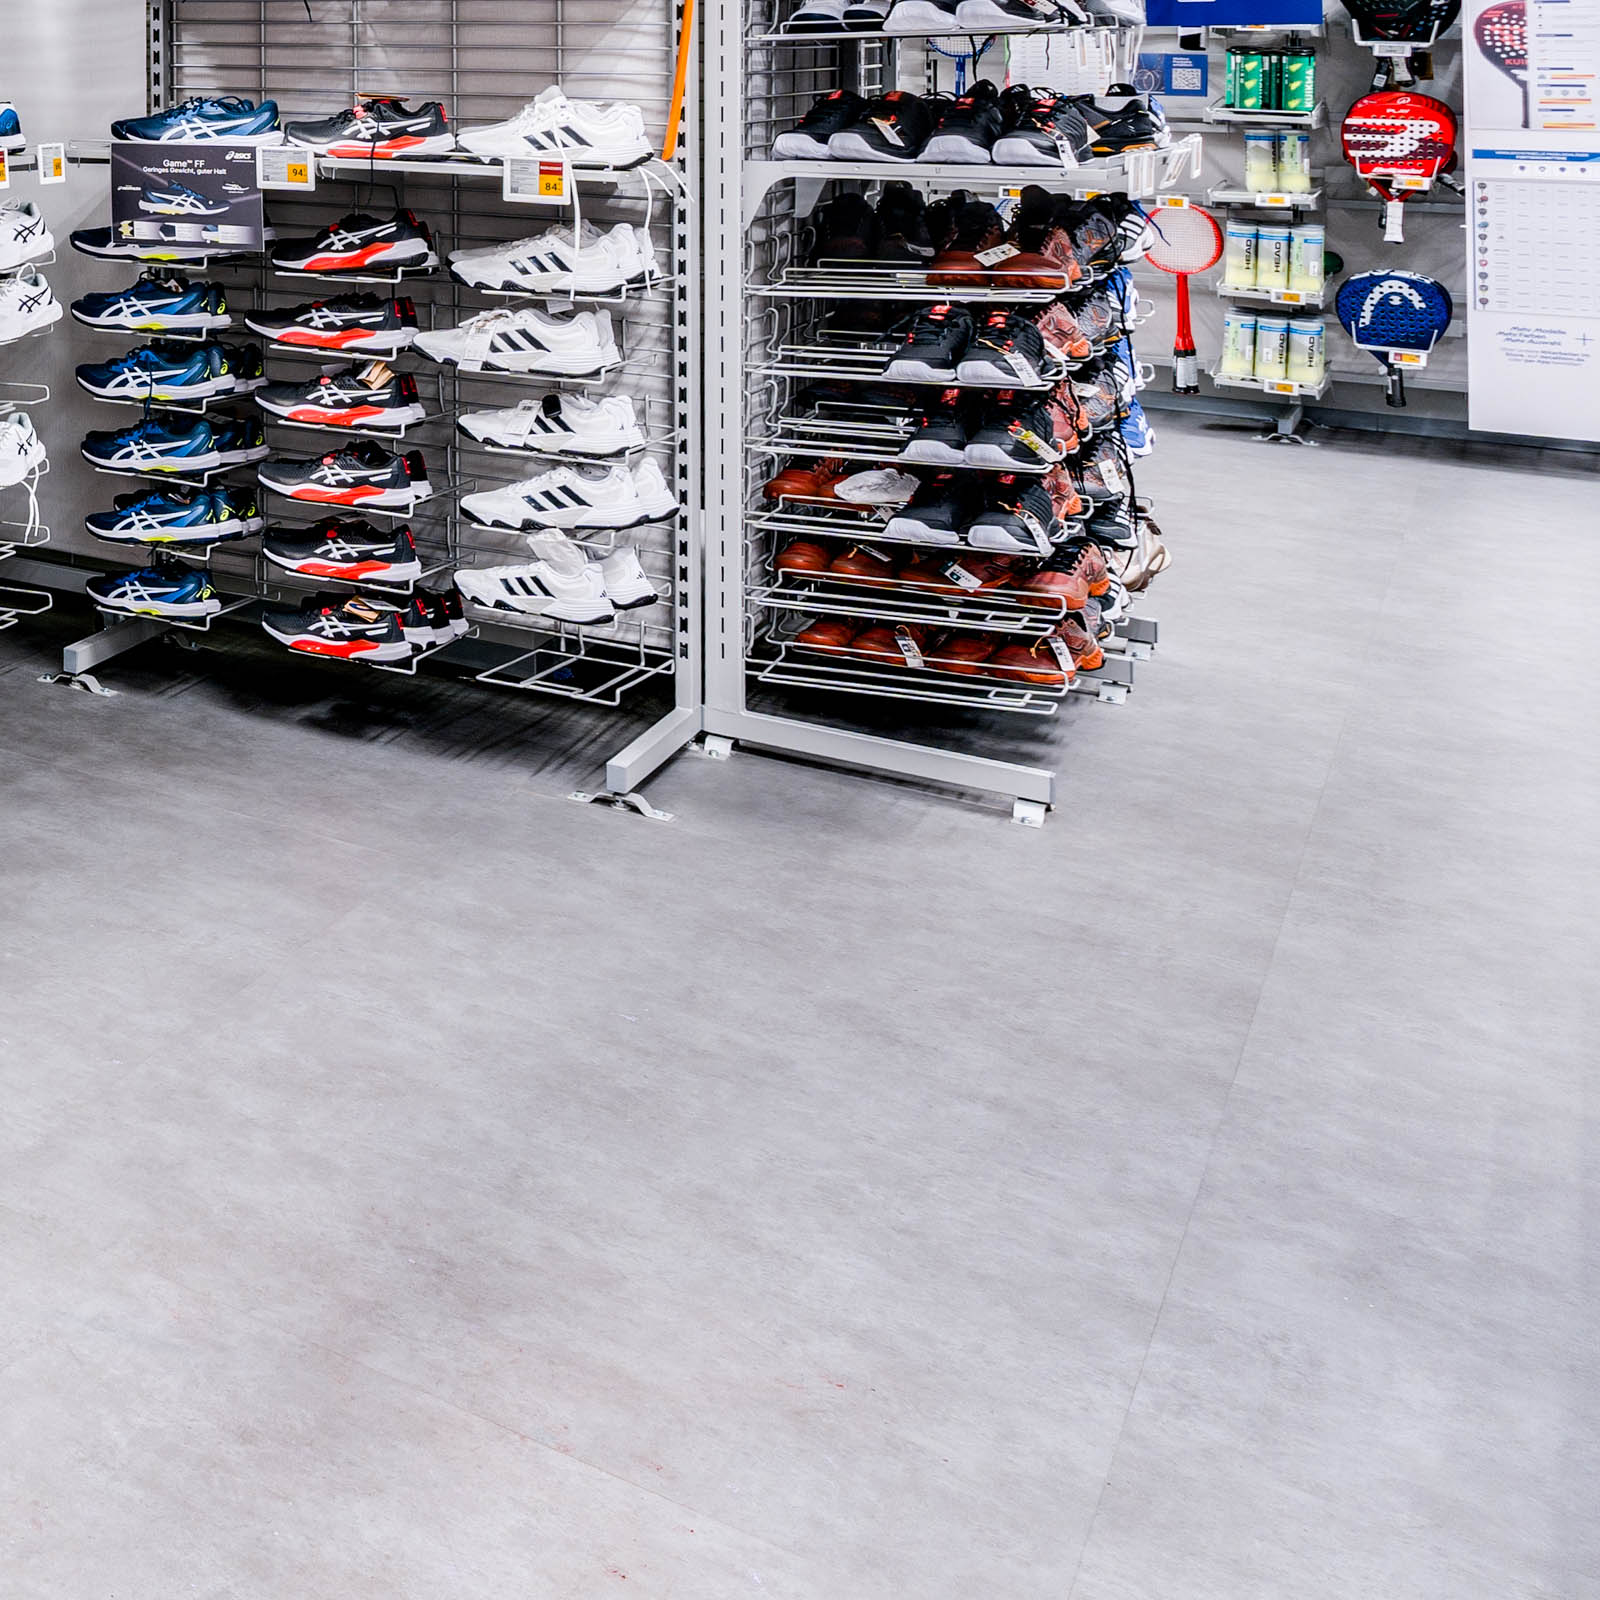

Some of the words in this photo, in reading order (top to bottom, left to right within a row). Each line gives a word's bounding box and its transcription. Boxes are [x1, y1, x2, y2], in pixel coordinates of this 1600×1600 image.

[1304, 69, 1314, 107] KUIKMA
[194, 160, 206, 168] FF
[1244, 239, 1253, 270] HEAD
[1274, 241, 1282, 273] HEAD
[1307, 336, 1315, 368] HEAD
